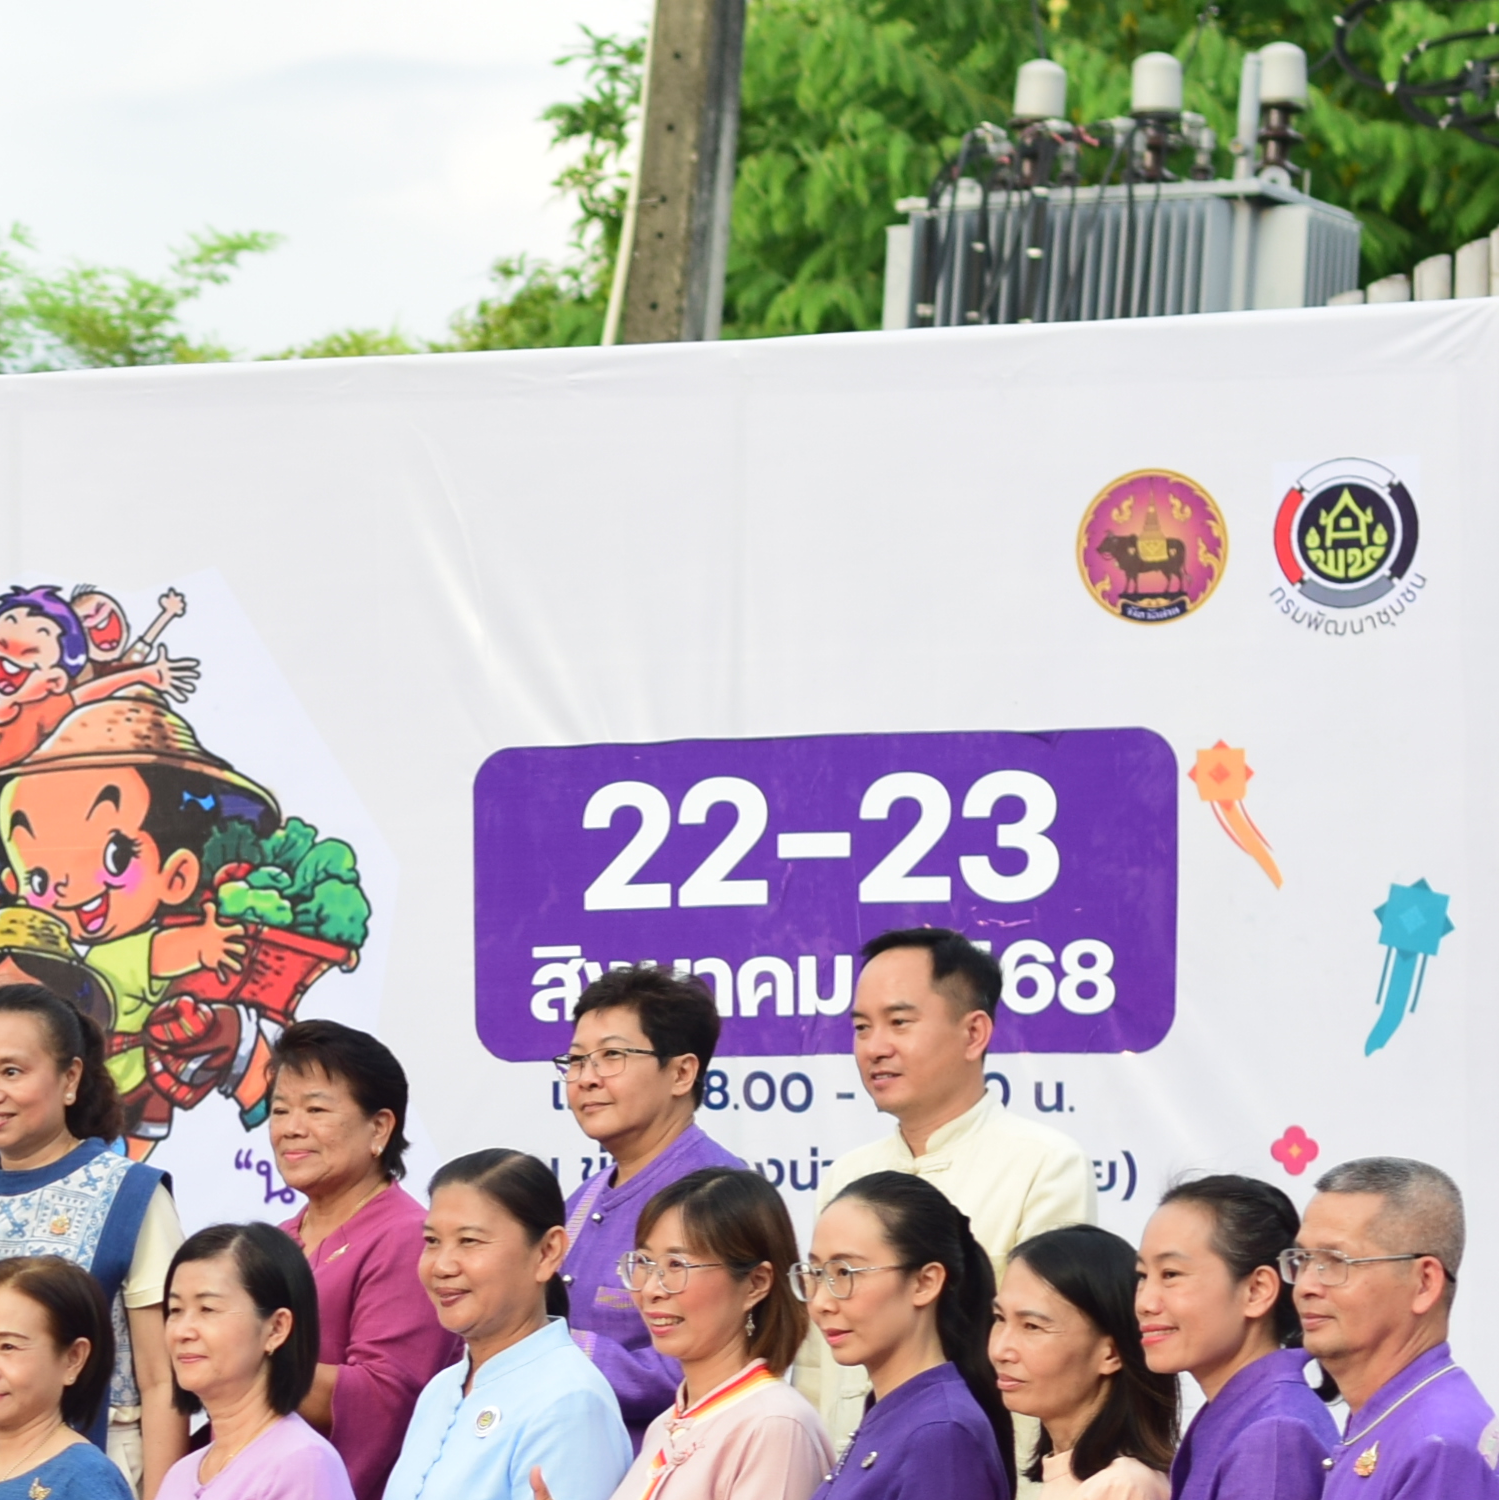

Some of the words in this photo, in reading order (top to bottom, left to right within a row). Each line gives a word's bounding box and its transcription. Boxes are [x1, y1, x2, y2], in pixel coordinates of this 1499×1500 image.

[1269, 572, 1428, 637] กรมพัฒนาชุมชน
[581, 770, 1061, 912] 22-23
[529, 945, 853, 1023] สิาคม
[703, 1069, 814, 1113] 8.00
